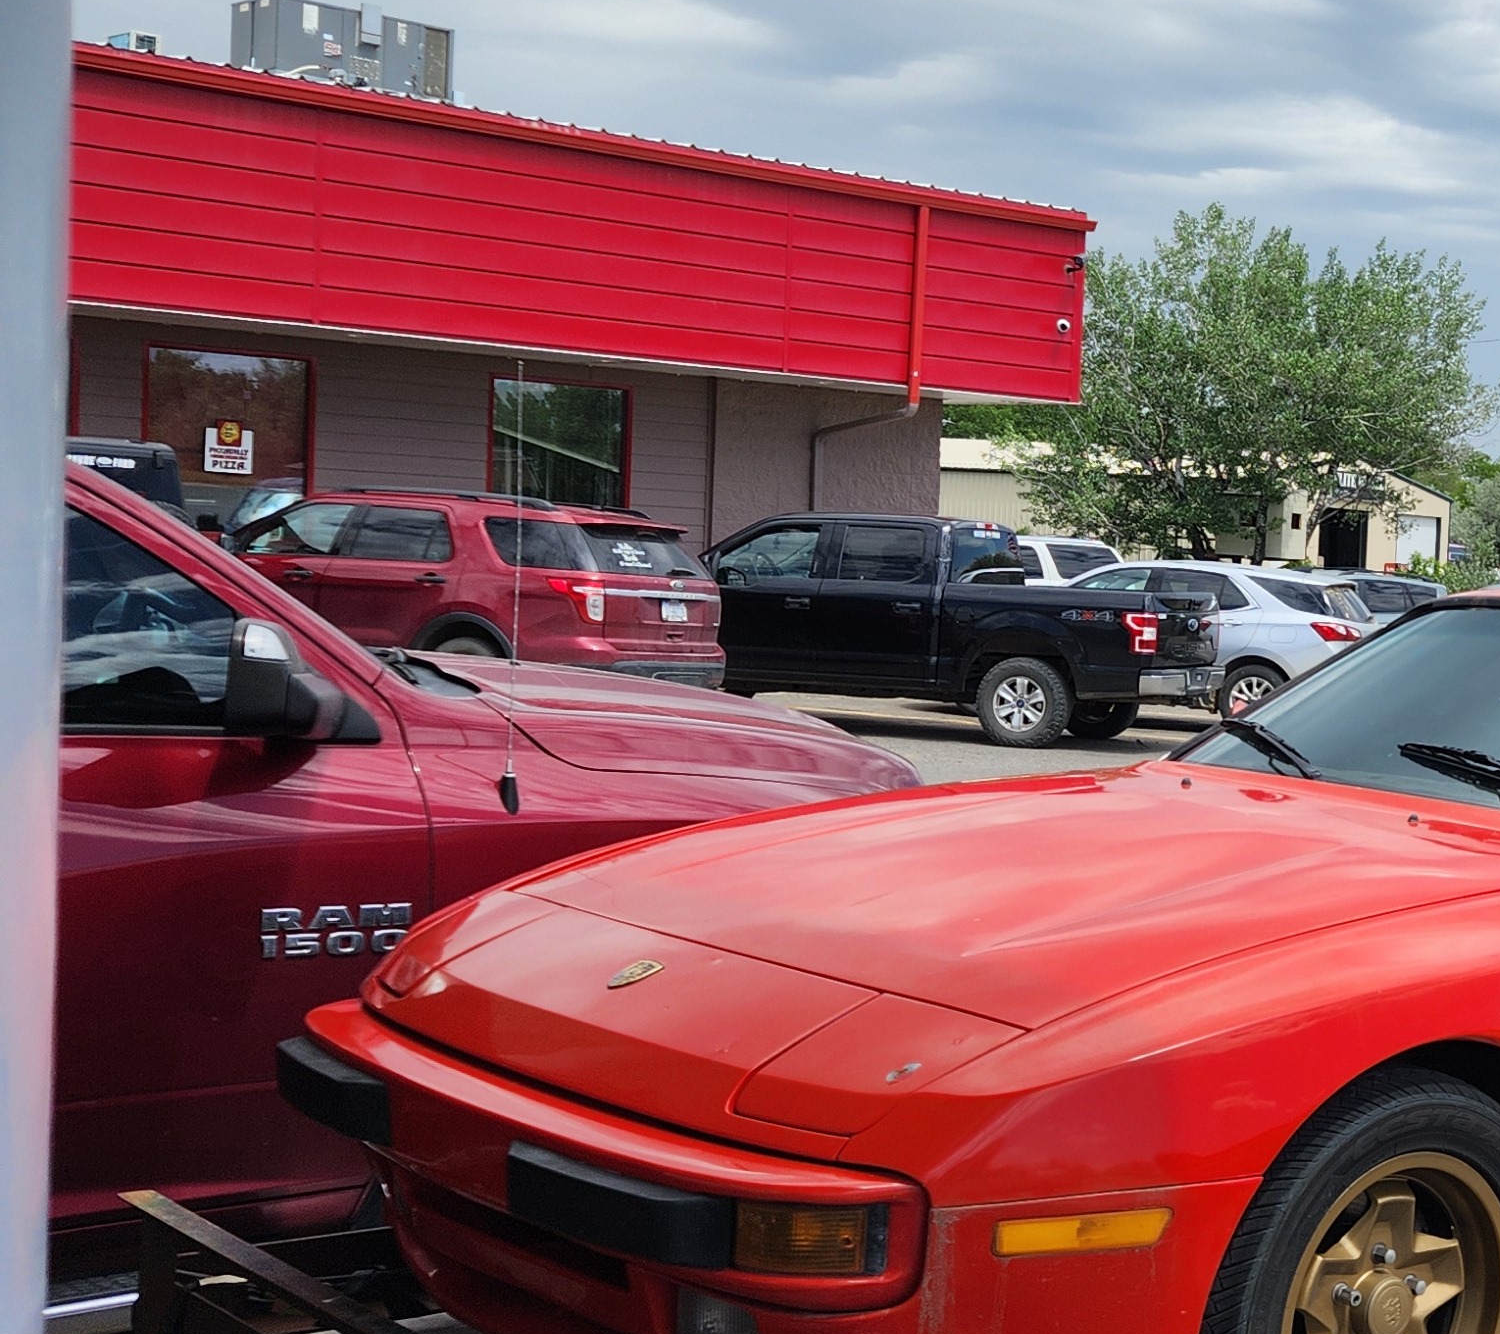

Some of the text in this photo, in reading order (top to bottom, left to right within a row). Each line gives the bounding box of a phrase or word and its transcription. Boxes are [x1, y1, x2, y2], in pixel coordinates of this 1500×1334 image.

[212, 460, 246, 470] PIZZA
[261, 902, 412, 931] RAM
[260, 928, 409, 958] 1500
